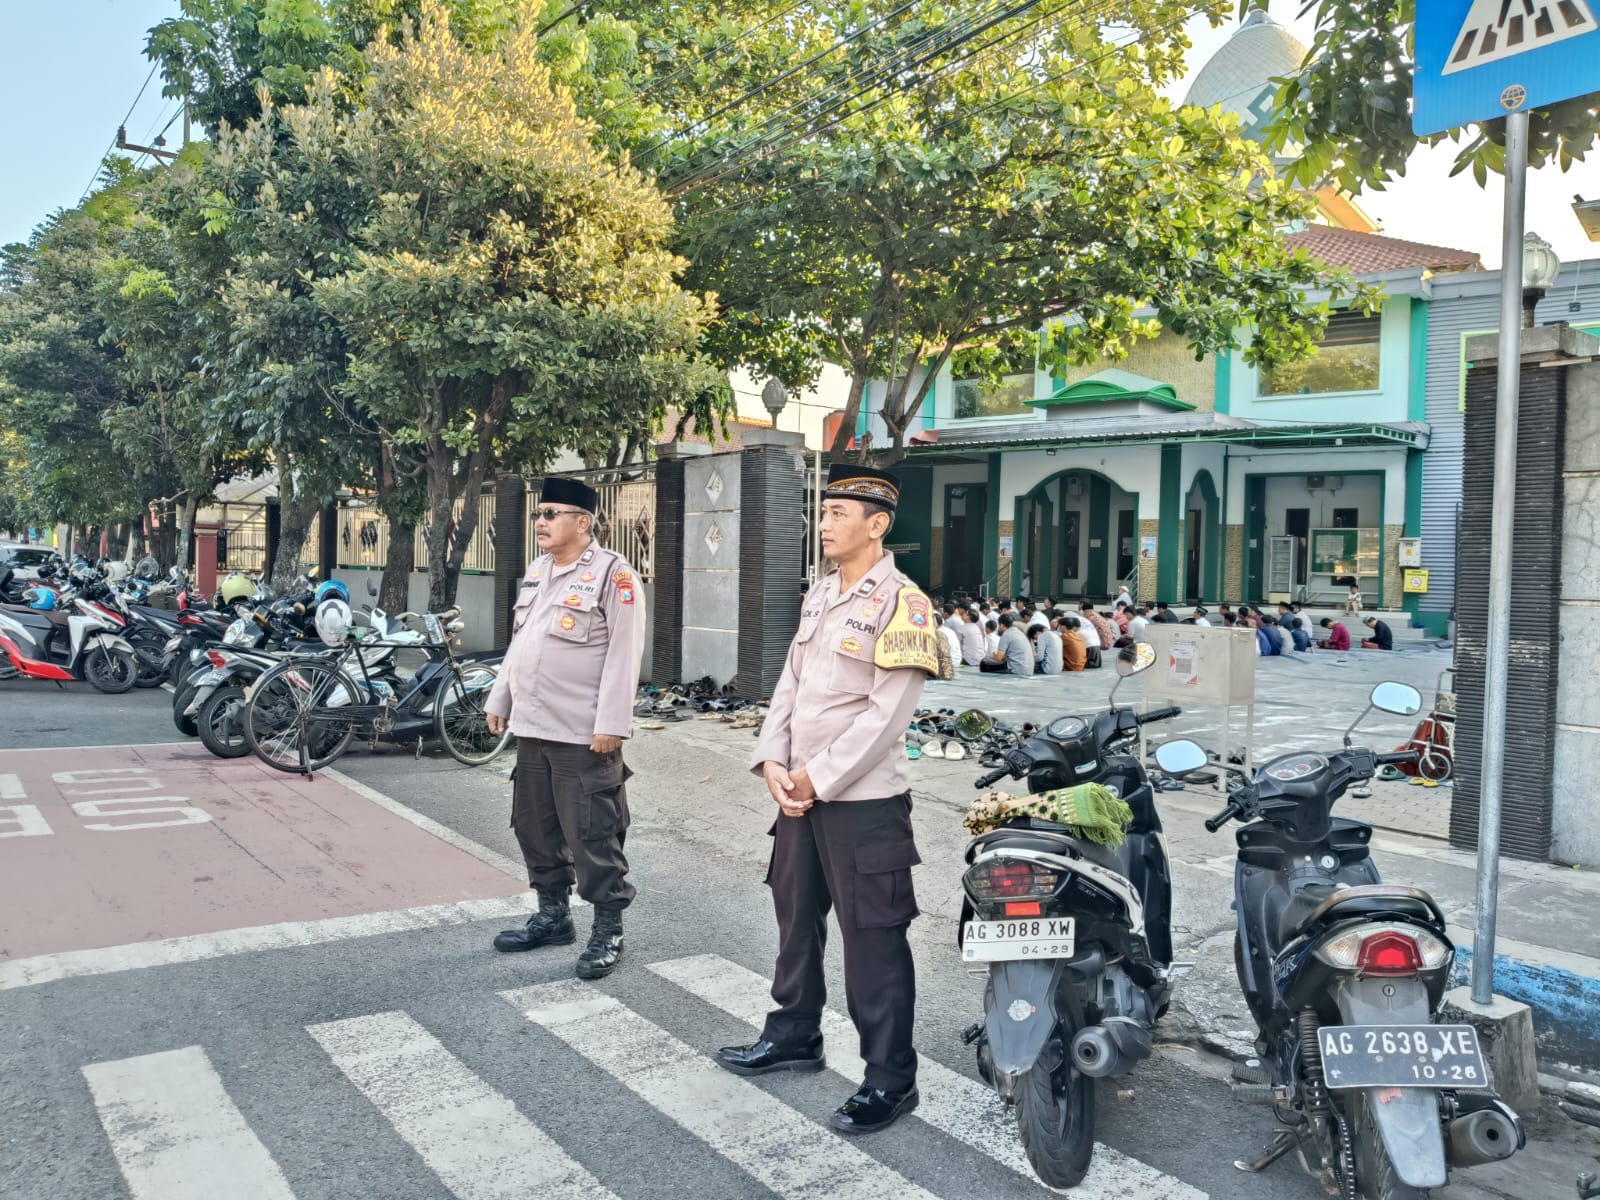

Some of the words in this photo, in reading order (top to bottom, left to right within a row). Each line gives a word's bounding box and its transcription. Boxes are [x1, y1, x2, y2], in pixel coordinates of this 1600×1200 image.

[569, 584, 595, 593] POLRI
[845, 618, 877, 635] POLRI
[965, 924, 987, 940] AG
[996, 921, 1040, 938] 3088
[1048, 920, 1070, 936] XW
[1325, 1032, 1354, 1056] AG
[1364, 1031, 1429, 1055] 2638
[1438, 1031, 1475, 1055] XE
